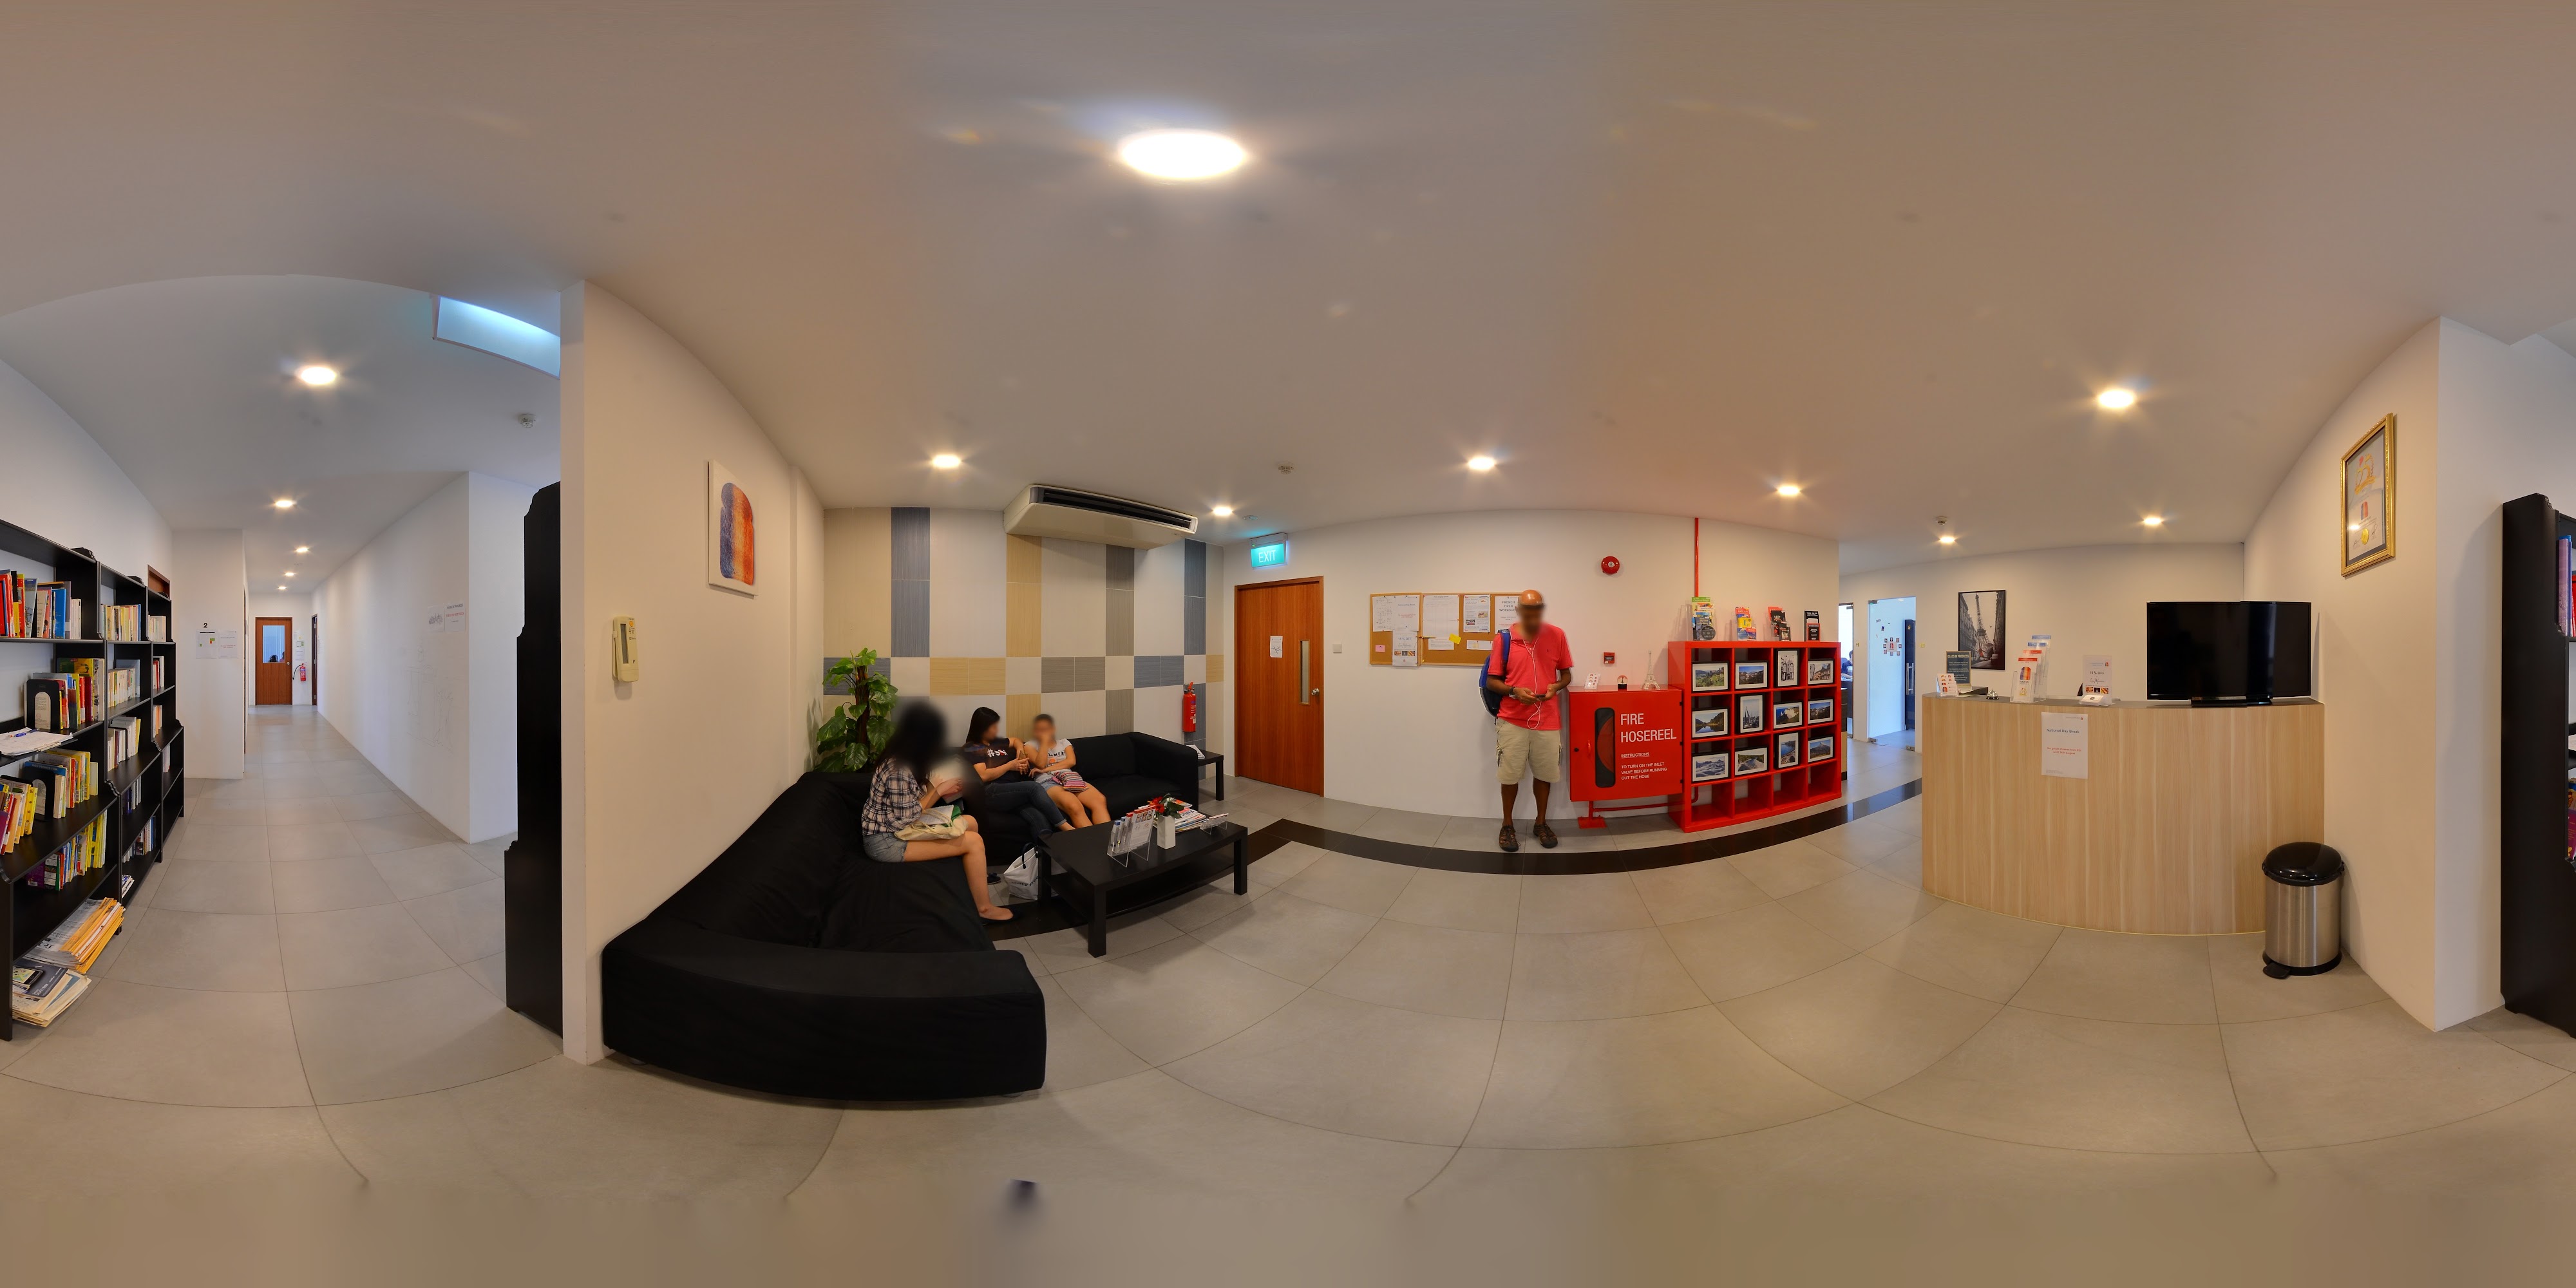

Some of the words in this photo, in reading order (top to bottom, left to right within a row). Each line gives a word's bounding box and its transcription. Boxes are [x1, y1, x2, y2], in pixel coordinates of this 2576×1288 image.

[1258, 550, 1276, 563] EXIT
[1621, 713, 1644, 725] FIRE
[1621, 729, 1677, 743] HOSEREEL
